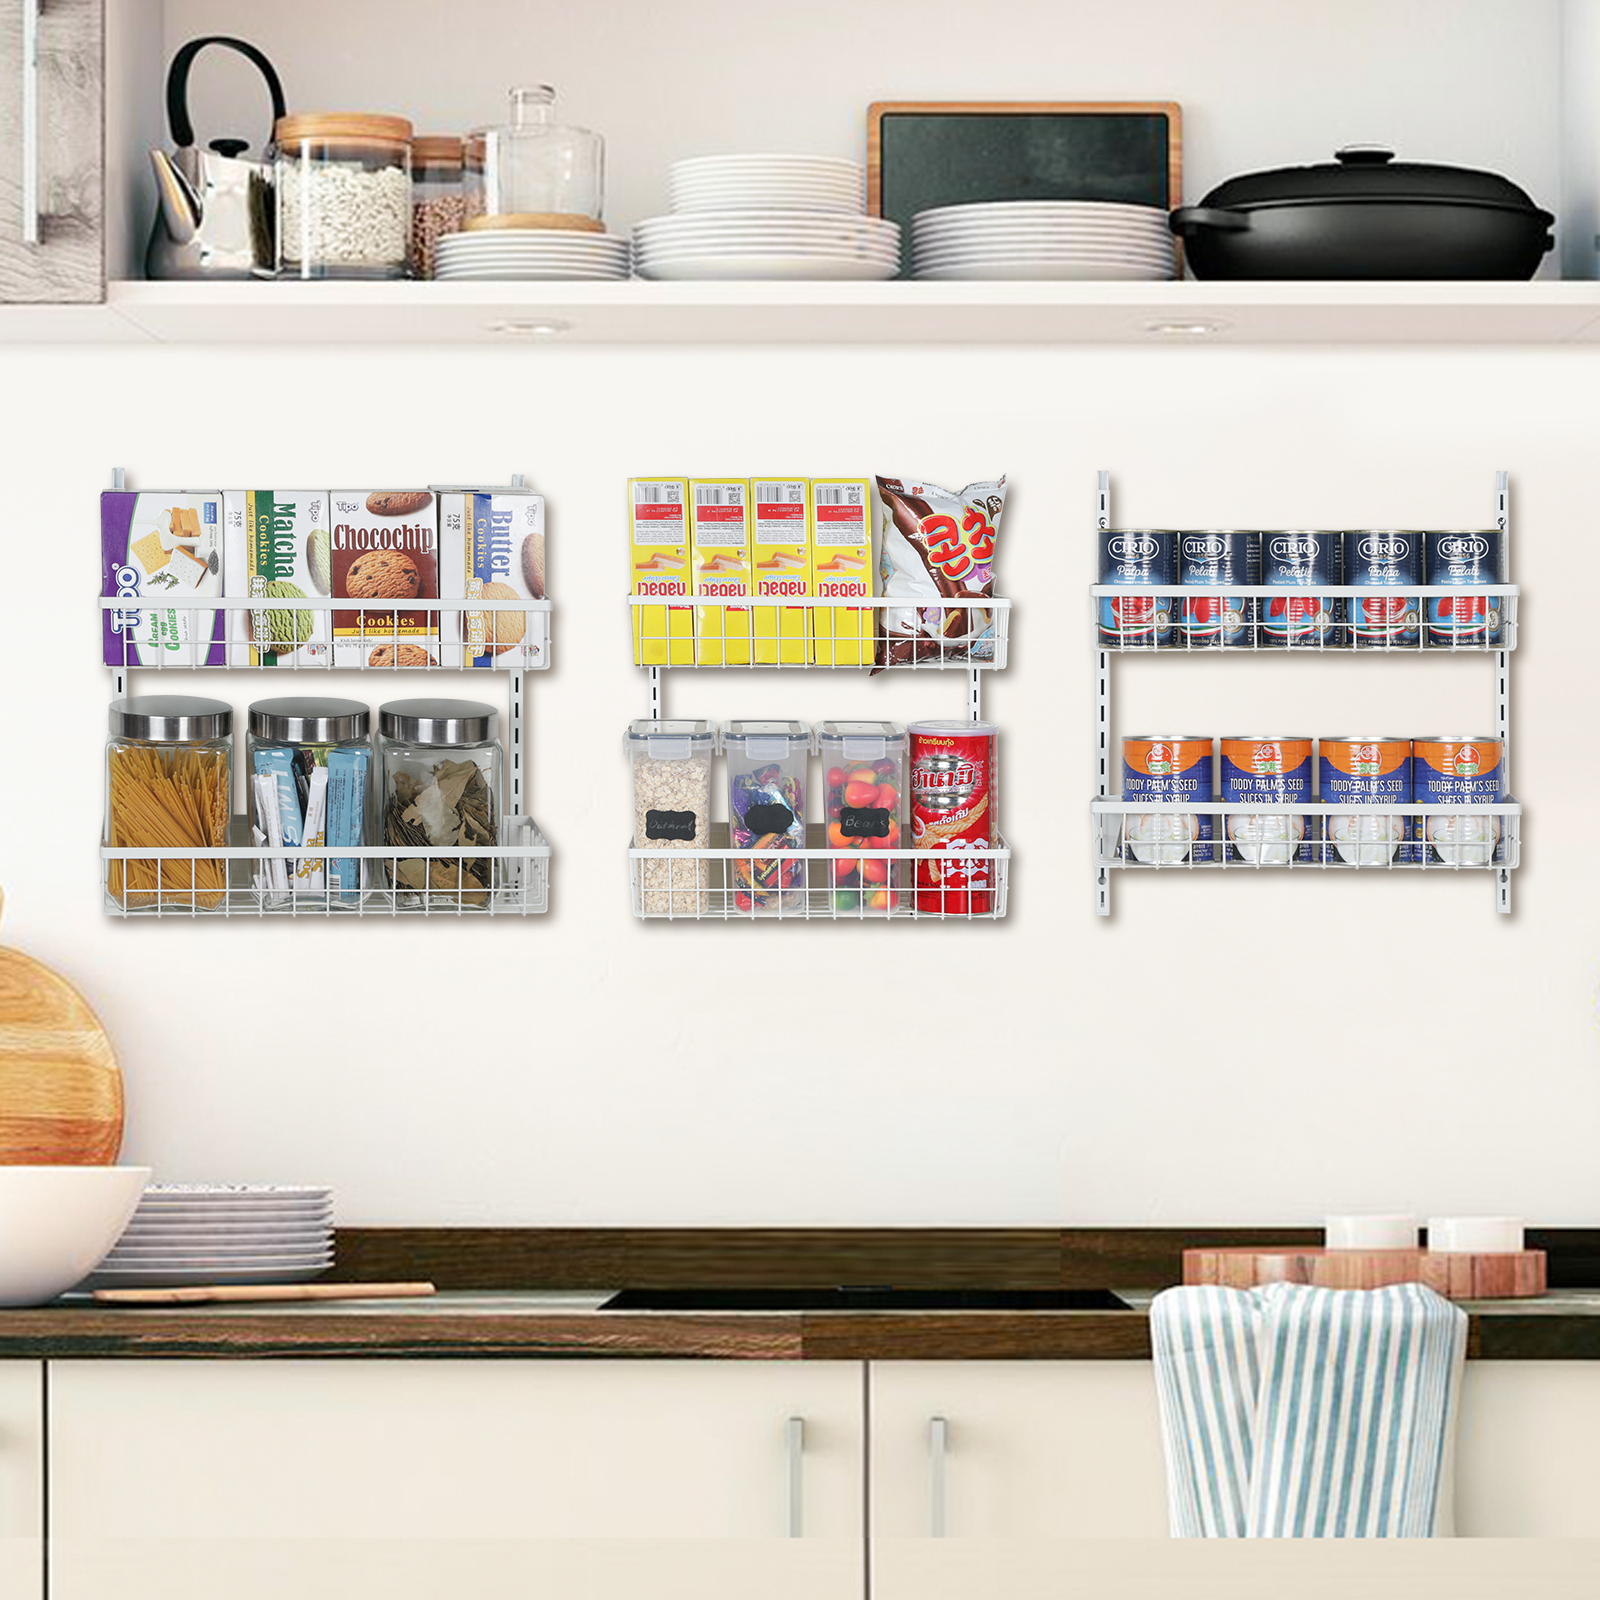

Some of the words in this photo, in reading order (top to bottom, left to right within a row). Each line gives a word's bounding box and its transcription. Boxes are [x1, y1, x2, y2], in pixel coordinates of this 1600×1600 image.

[309, 500, 322, 523] Tipo
[336, 501, 360, 513] Tipo
[525, 504, 537, 526] Tipo
[452, 514, 460, 531] 75克
[259, 515, 270, 566] Cookies
[274, 503, 297, 577] Matcha
[334, 524, 434, 553] Chocochip
[477, 518, 487, 568] Cookies
[491, 510, 513, 577] Butter
[919, 505, 996, 577] 콘초
[1112, 541, 1154, 553] CIRIO
[1185, 541, 1222, 554] CIRIO
[1273, 542, 1314, 554] CIRIO
[1363, 542, 1405, 554] CIRIO
[1442, 541, 1484, 553] CIRIO
[1117, 565, 1149, 579] Polpa
[1189, 565, 1217, 577] Pelati
[1279, 566, 1309, 577] Pelati
[1368, 566, 1400, 580] Polpa
[1448, 565, 1480, 576] Pelati
[356, 616, 415, 627] Cookies
[160, 621, 168, 636] egg
[1125, 779, 1145, 790] TODDY
[1146, 779, 1176, 791] PALM'S
[1179, 779, 1198, 790] SEED
[1230, 778, 1253, 790] TODDY
[1255, 779, 1286, 791] PALM'S
[1287, 779, 1304, 790] SEED
[1330, 780, 1353, 791] TODDY
[1354, 780, 1385, 792] PALM'S
[1386, 780, 1404, 791] SEED
[1427, 780, 1453, 792] TODDY
[1454, 781, 1483, 792] PALM'S
[1485, 780, 1500, 791] SEED
[1133, 793, 1154, 802] SLICES
[1165, 794, 1190, 802] SYRUP
[1239, 793, 1263, 803] SLICES
[1274, 793, 1298, 803] SYRUP
[1339, 795, 1362, 804] SLICES
[1373, 795, 1397, 804] SYRUP
[1437, 795, 1462, 804] SLICES
[1473, 795, 1495, 804] SYRUP
